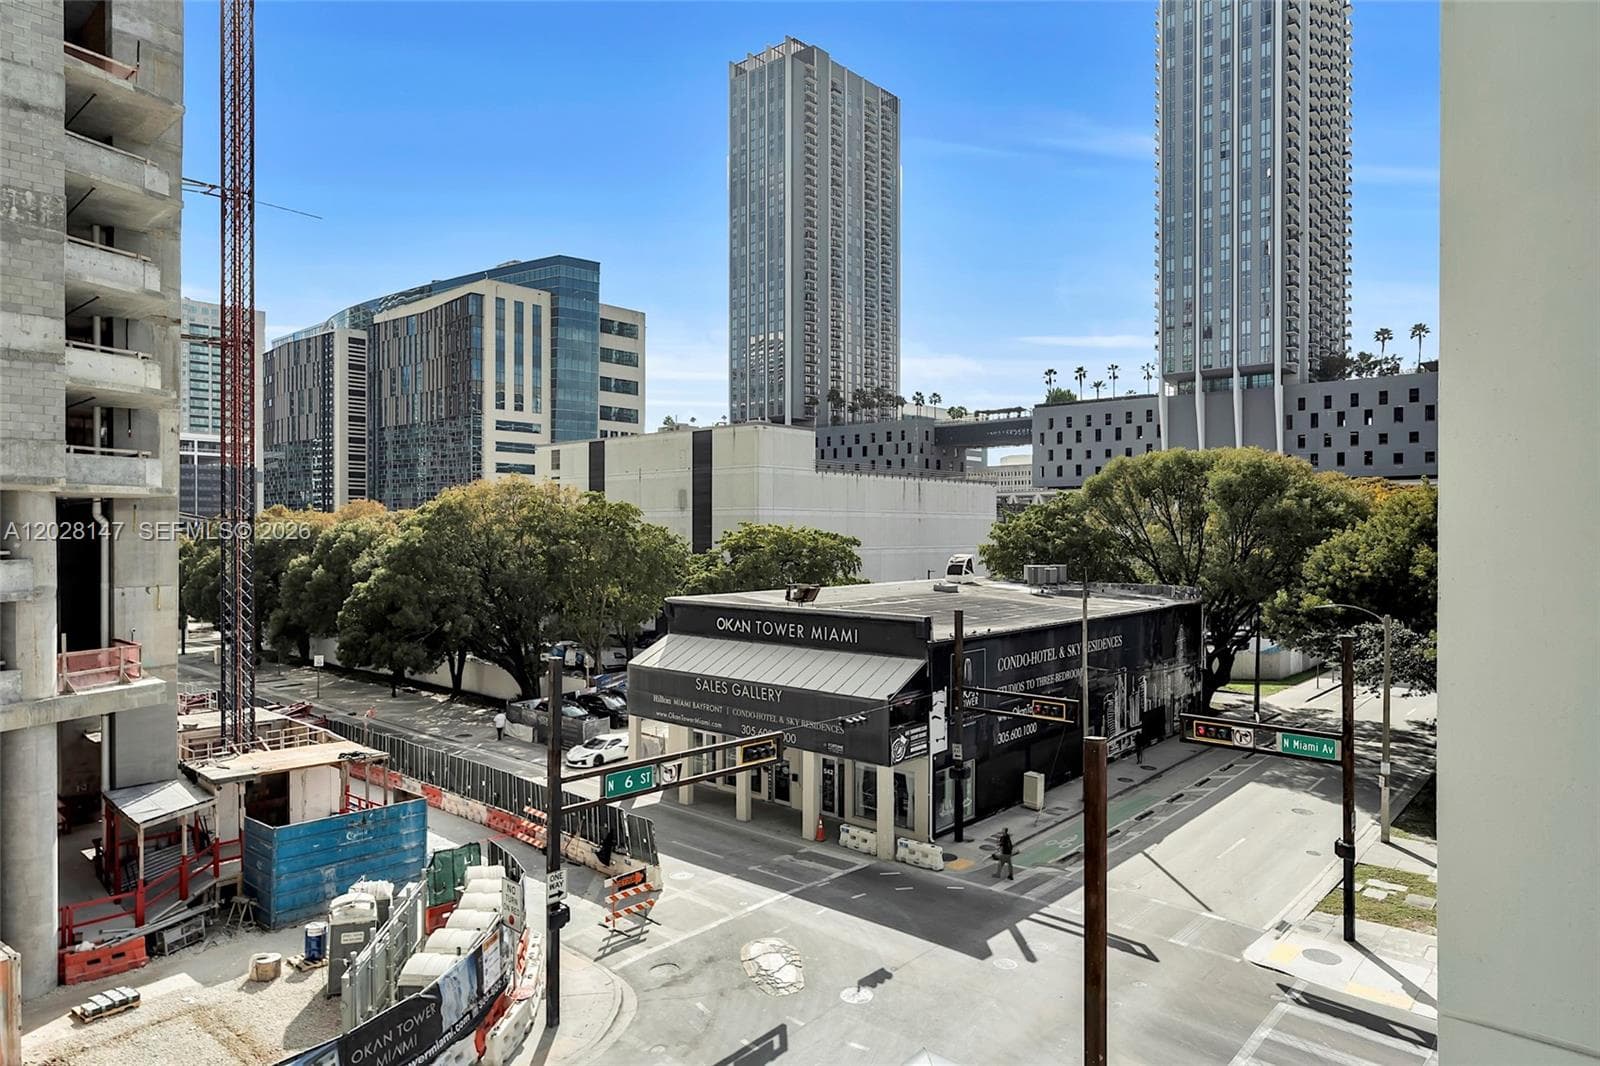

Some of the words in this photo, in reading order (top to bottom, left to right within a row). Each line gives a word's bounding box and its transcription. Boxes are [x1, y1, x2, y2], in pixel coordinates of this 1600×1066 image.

[716, 617, 751, 632] OKAN
[755, 621, 805, 638] TOWER
[811, 626, 859, 643] MIAMI
[997, 647, 1058, 673] CONDO-HOTEL
[1058, 646, 1066, 659] &
[1067, 643, 1082, 656] SKY
[1085, 634, 1123, 653] ESIDENCES
[695, 678, 729, 696] SALES
[731, 683, 783, 703] GALLERY
[1025, 680, 1036, 690] TO
[1036, 668, 1087, 687] THREE-BEDROOM
[673, 698, 692, 709] MIAMI
[692, 701, 723, 714] BAYFRONT
[779, 715, 784, 724] &
[786, 717, 800, 728] SKY
[801, 719, 845, 735] RESIDENCES
[997, 722, 1038, 745] 305.600.1000
[1283, 738, 1289, 748] N
[1293, 739, 1319, 752] Miami
[1322, 743, 1334, 754] Av
[608, 781, 614, 792] N
[624, 775, 633, 788] 6
[640, 772, 650, 784] ST
[549, 871, 565, 881] ONE
[549, 880, 564, 891] WAY
[506, 884, 517, 896] NO
[350, 1030, 394, 1065] OKAN
[396, 1003, 438, 1034] TOWER
[375, 1034, 419, 1066] MIAMI
